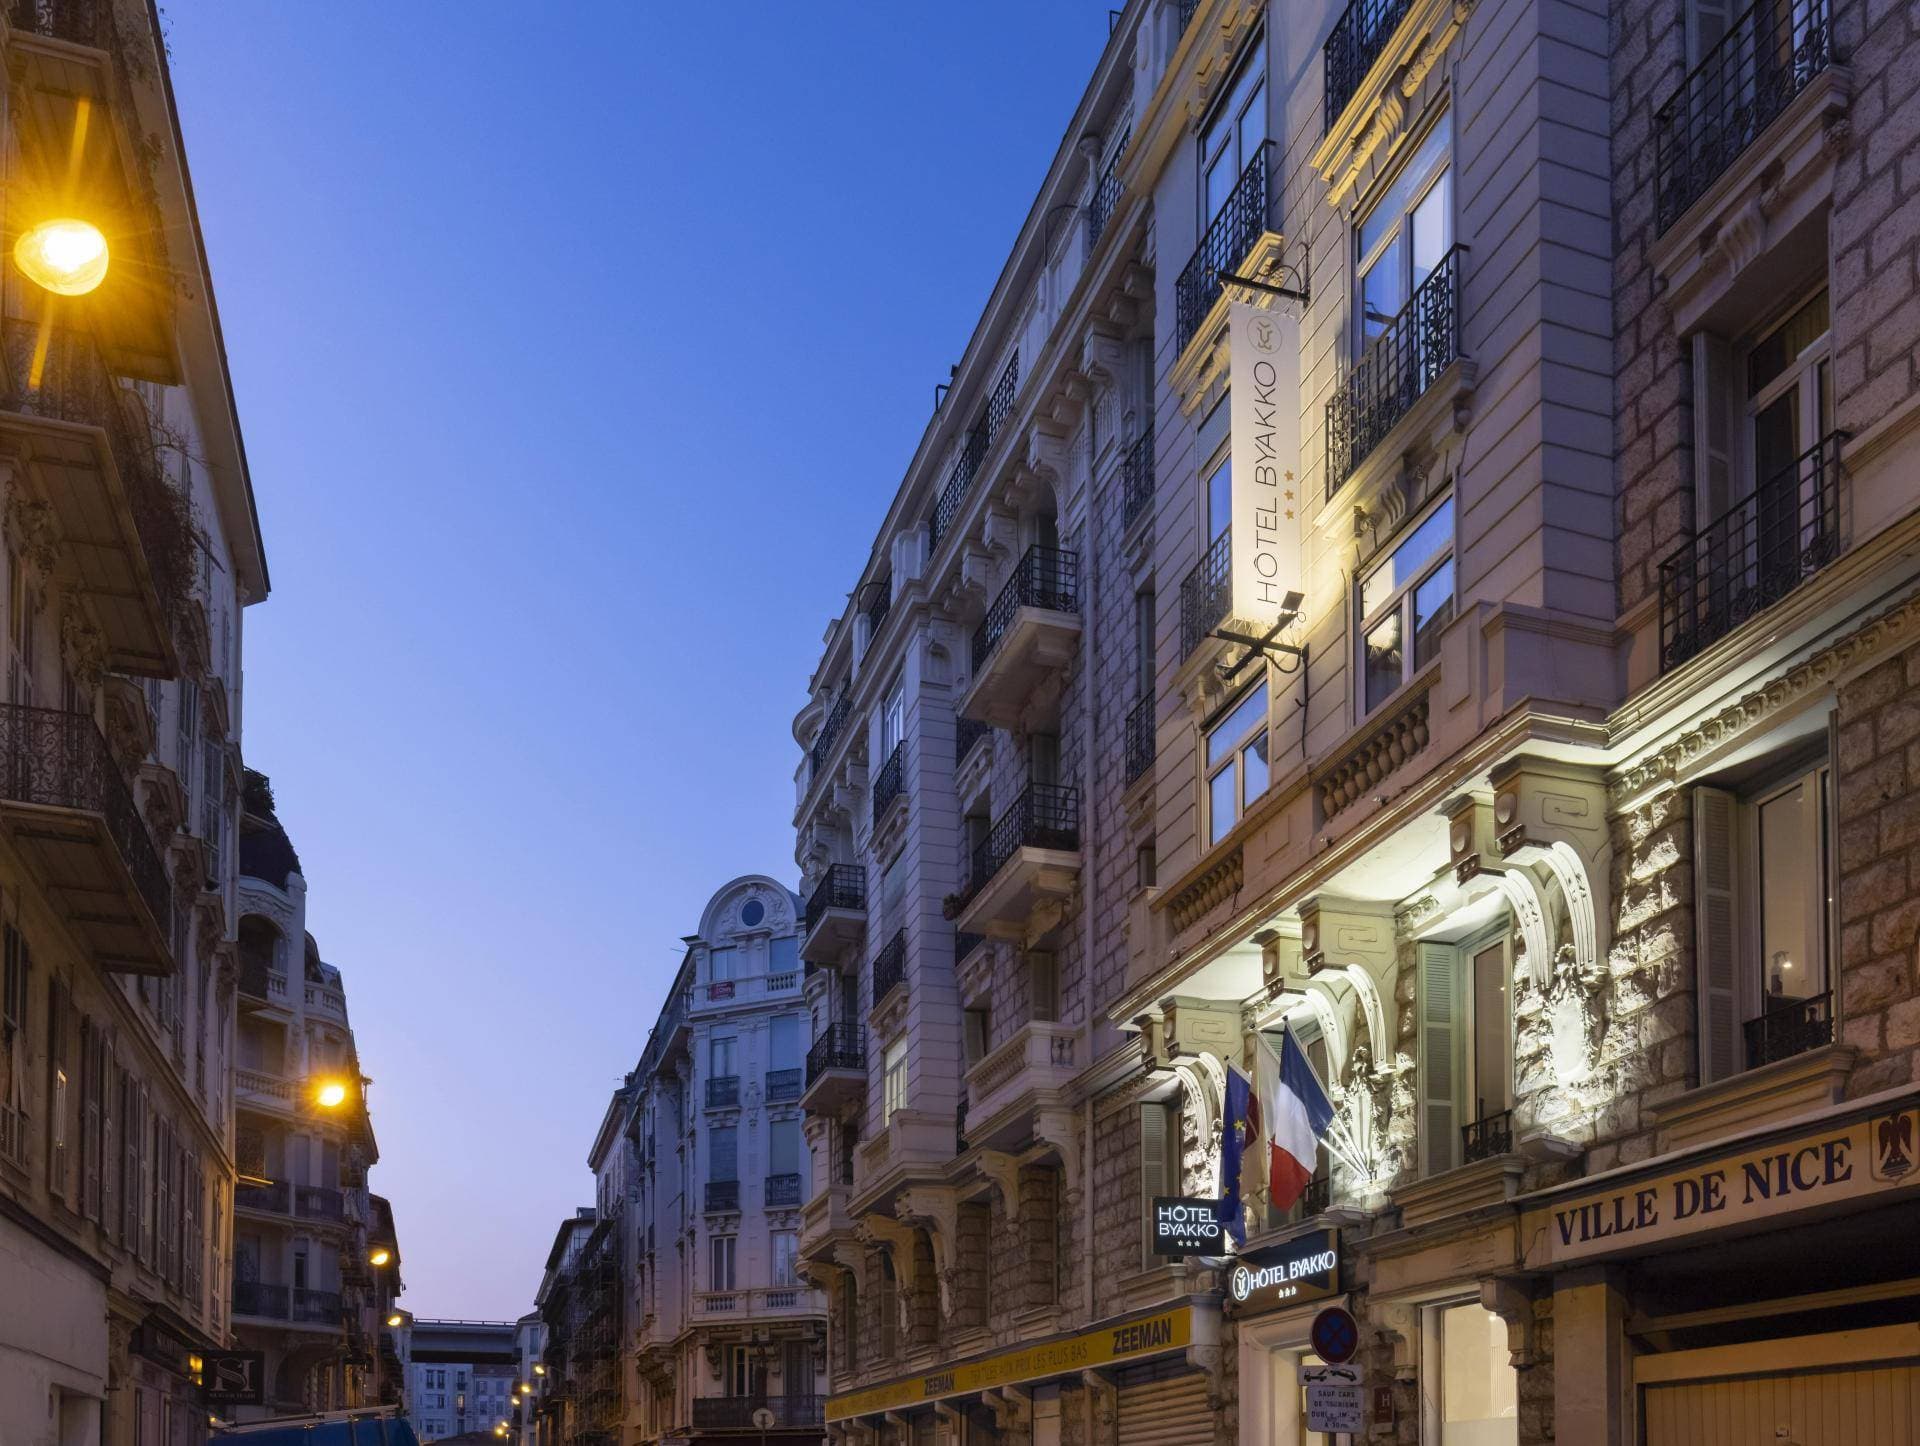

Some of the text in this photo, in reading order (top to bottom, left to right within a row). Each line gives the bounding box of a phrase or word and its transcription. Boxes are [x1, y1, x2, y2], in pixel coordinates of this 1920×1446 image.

[1253, 361, 1278, 604] HÔTEL BYAKKO
[1555, 1137, 1854, 1246] VILLE DE NICE
[1158, 1204, 1218, 1223] HÔTEL
[1159, 1222, 1219, 1238] BYAKKO
[1249, 1250, 1337, 1290] HÔTEL BYAKKO
[924, 1372, 955, 1396] ZEEMAN
[1048, 1347, 1069, 1366] PLUS
[1070, 1341, 1088, 1361] BAS
[1112, 1317, 1172, 1355] ZEEMAN
[1382, 1394, 1390, 1407] H
